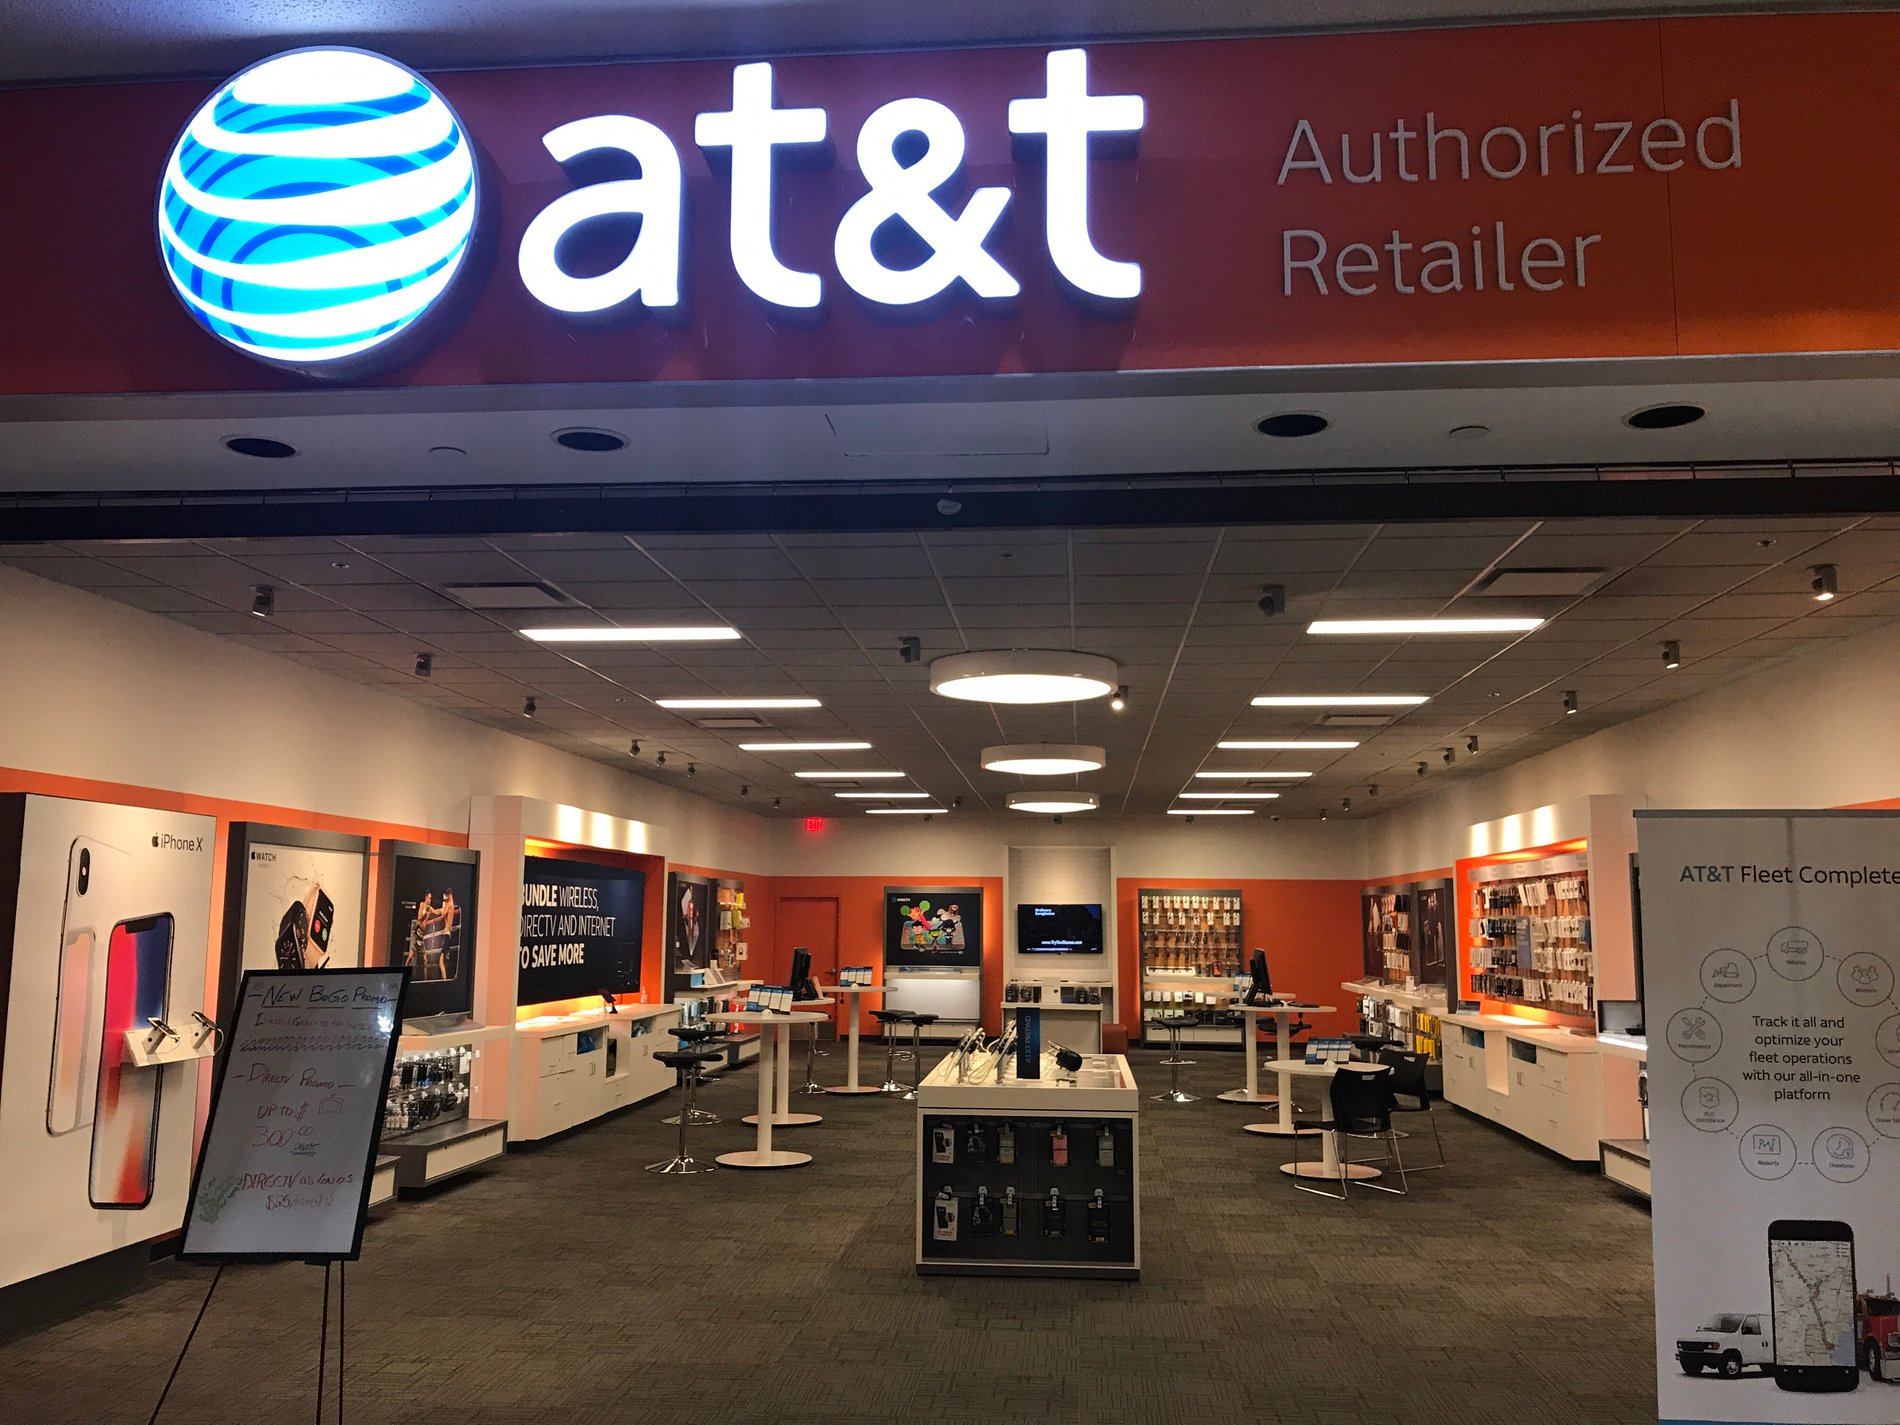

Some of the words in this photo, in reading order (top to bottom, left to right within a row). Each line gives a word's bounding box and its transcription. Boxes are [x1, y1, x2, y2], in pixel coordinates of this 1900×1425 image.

[1276, 98, 1742, 185] Authorized
[518, 48, 1144, 312] at&t
[1283, 222, 1601, 297] Retailer
[806, 818, 823, 831] EXIT
[160, 834, 195, 851] iPhone
[196, 837, 204, 852] X
[256, 852, 277, 862] WATCH
[1680, 865, 1734, 883] AT&T
[1741, 865, 1793, 884] Fleet
[1799, 866, 1900, 888] Complete
[559, 886, 599, 911] WIRELESS,
[557, 915, 577, 936] AND
[578, 915, 616, 937] INTERNET
[532, 944, 557, 968] SAVE
[558, 943, 585, 965] MORE
[262, 983, 303, 1006] NEW
[1752, 1015, 1788, 1028] Track
[1791, 1016, 1800, 1028] it
[1803, 1016, 1817, 1028] all
[1820, 1017, 1845, 1028] and
[1755, 1034, 1811, 1047] optimize
[1814, 1037, 1844, 1048] your
[1749, 1050, 1780, 1063] fleet
[1782, 1053, 1853, 1066] operations
[1742, 1069, 1771, 1081] with
[1774, 1072, 1796, 1082] our
[1799, 1070, 1861, 1083] all-in-one
[1774, 1088, 1831, 1102] platform
[257, 1103, 278, 1120] UP
[1757, 1159, 1780, 1167] Reports
[241, 1171, 301, 1191] DIRECTV
